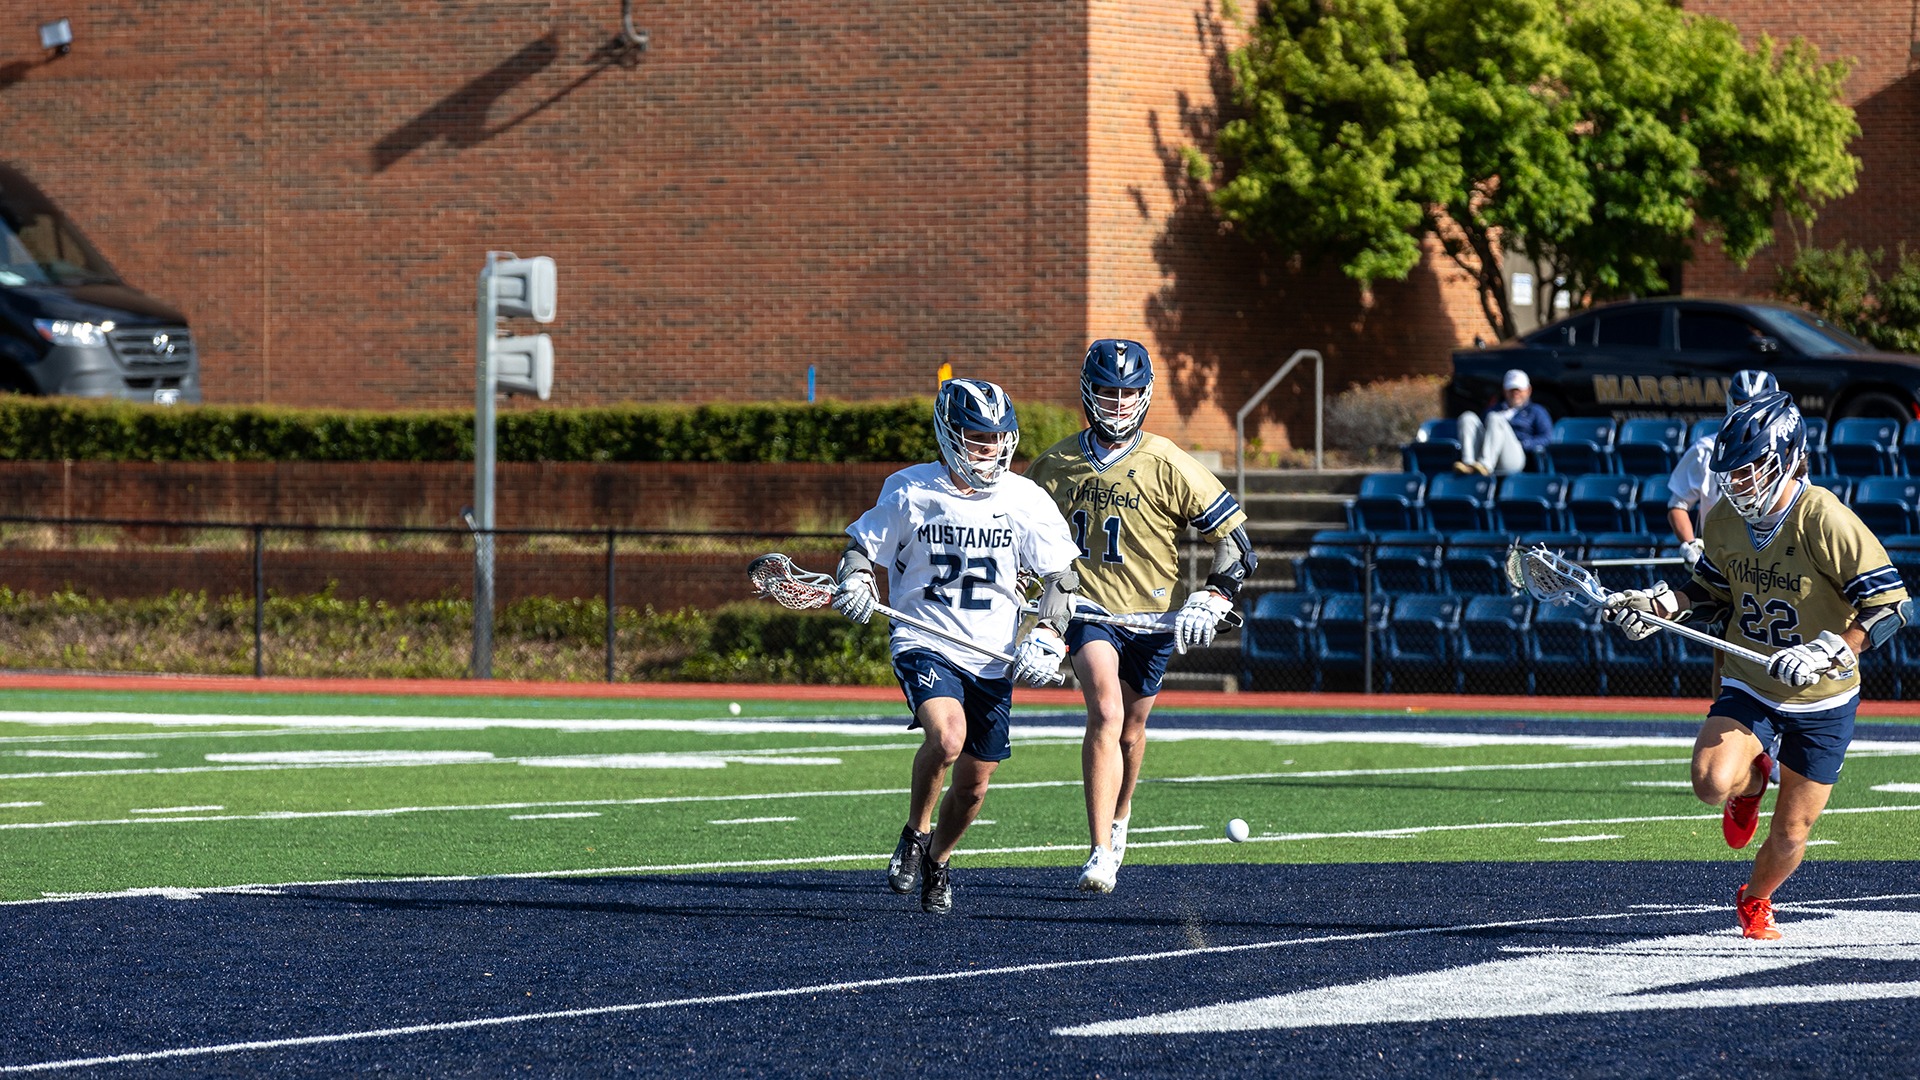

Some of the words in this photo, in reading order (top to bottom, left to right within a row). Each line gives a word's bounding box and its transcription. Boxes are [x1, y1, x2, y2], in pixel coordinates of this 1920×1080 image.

[1066, 478, 1141, 511] Whitefield
[917, 524, 1013, 549] MUSTANGS
[1071, 509, 1124, 564] 11
[923, 553, 997, 610] 22
[1728, 557, 1802, 595] Whitefield
[1738, 591, 1804, 649] 22
